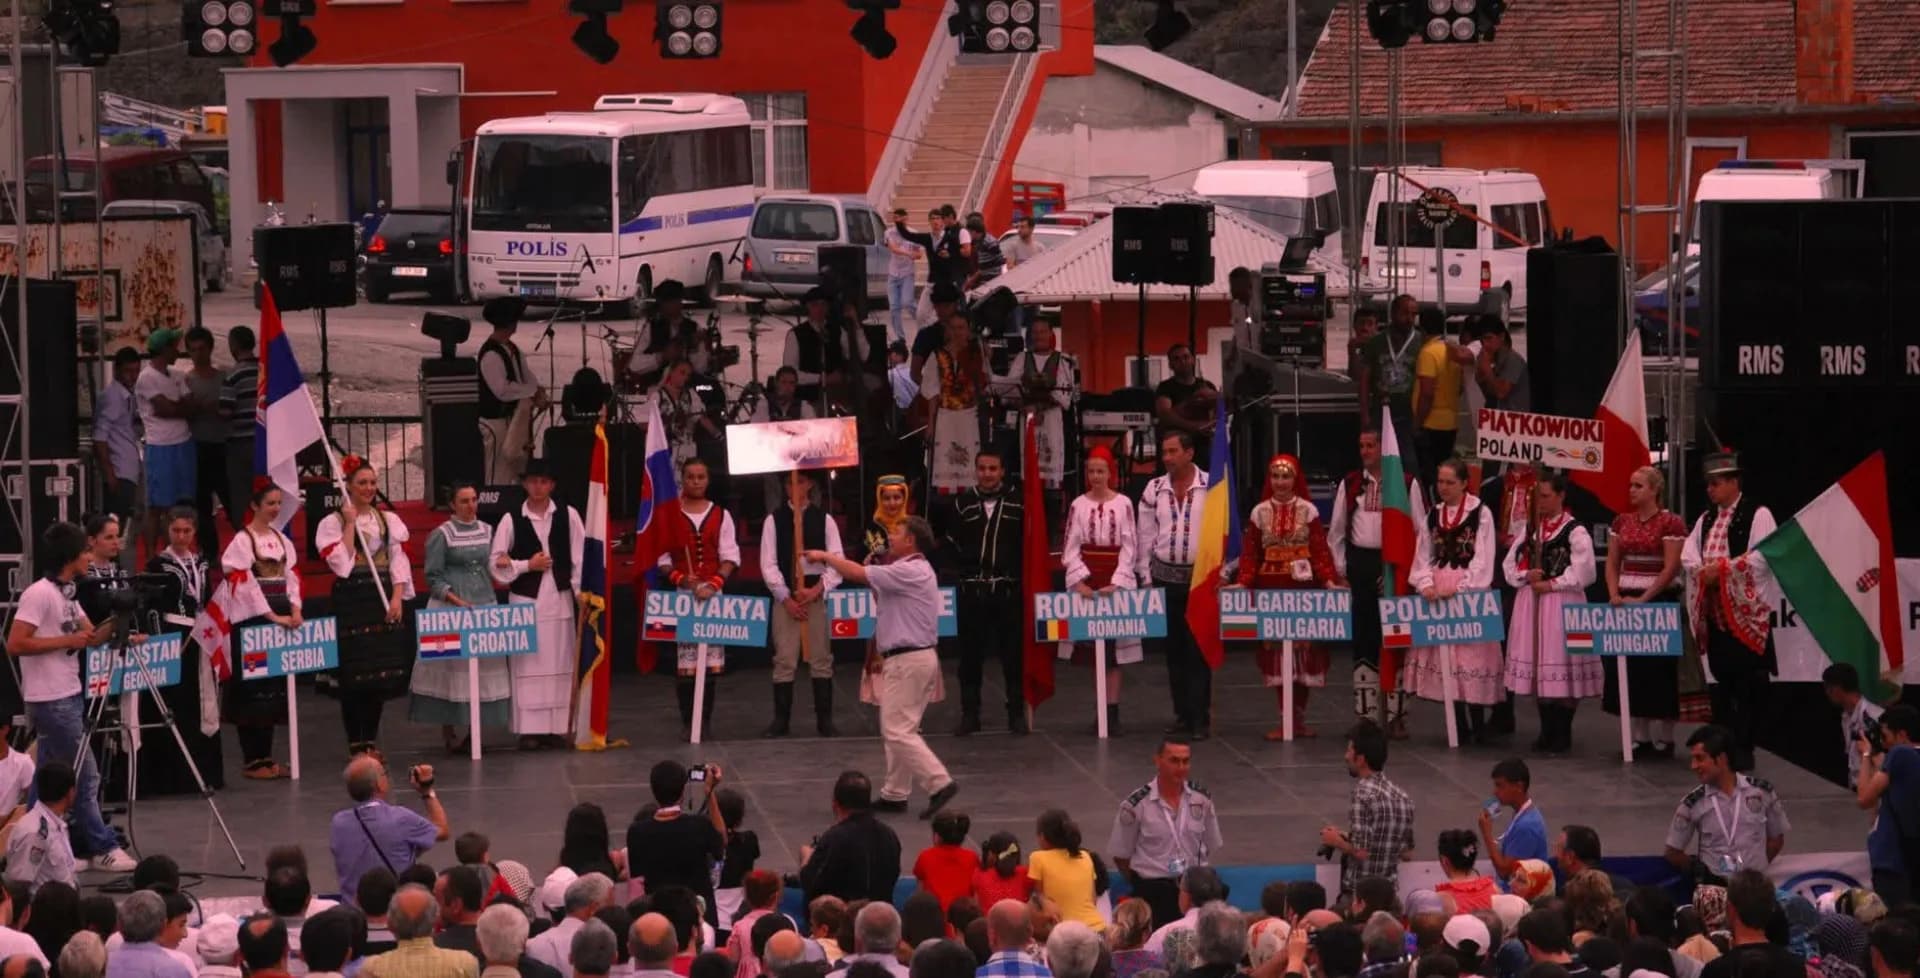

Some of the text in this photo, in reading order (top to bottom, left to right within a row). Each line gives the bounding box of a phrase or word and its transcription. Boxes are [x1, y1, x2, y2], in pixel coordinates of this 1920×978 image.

[1738, 345, 1784, 375] RMS
[1820, 345, 1866, 375] RMS
[1480, 437, 1543, 461] POLAND
[647, 592, 766, 622] SLOVAKYA
[1035, 589, 1164, 619] ROMANYA
[692, 622, 749, 640] SLOVAKIA
[1088, 619, 1148, 637] ROMANIA
[1263, 617, 1346, 639] BULGARIA
[1427, 622, 1483, 641] POLAND
[468, 630, 529, 654] CROATIA
[1602, 633, 1669, 653] HUNGARY
[281, 646, 325, 673] SERBIA
